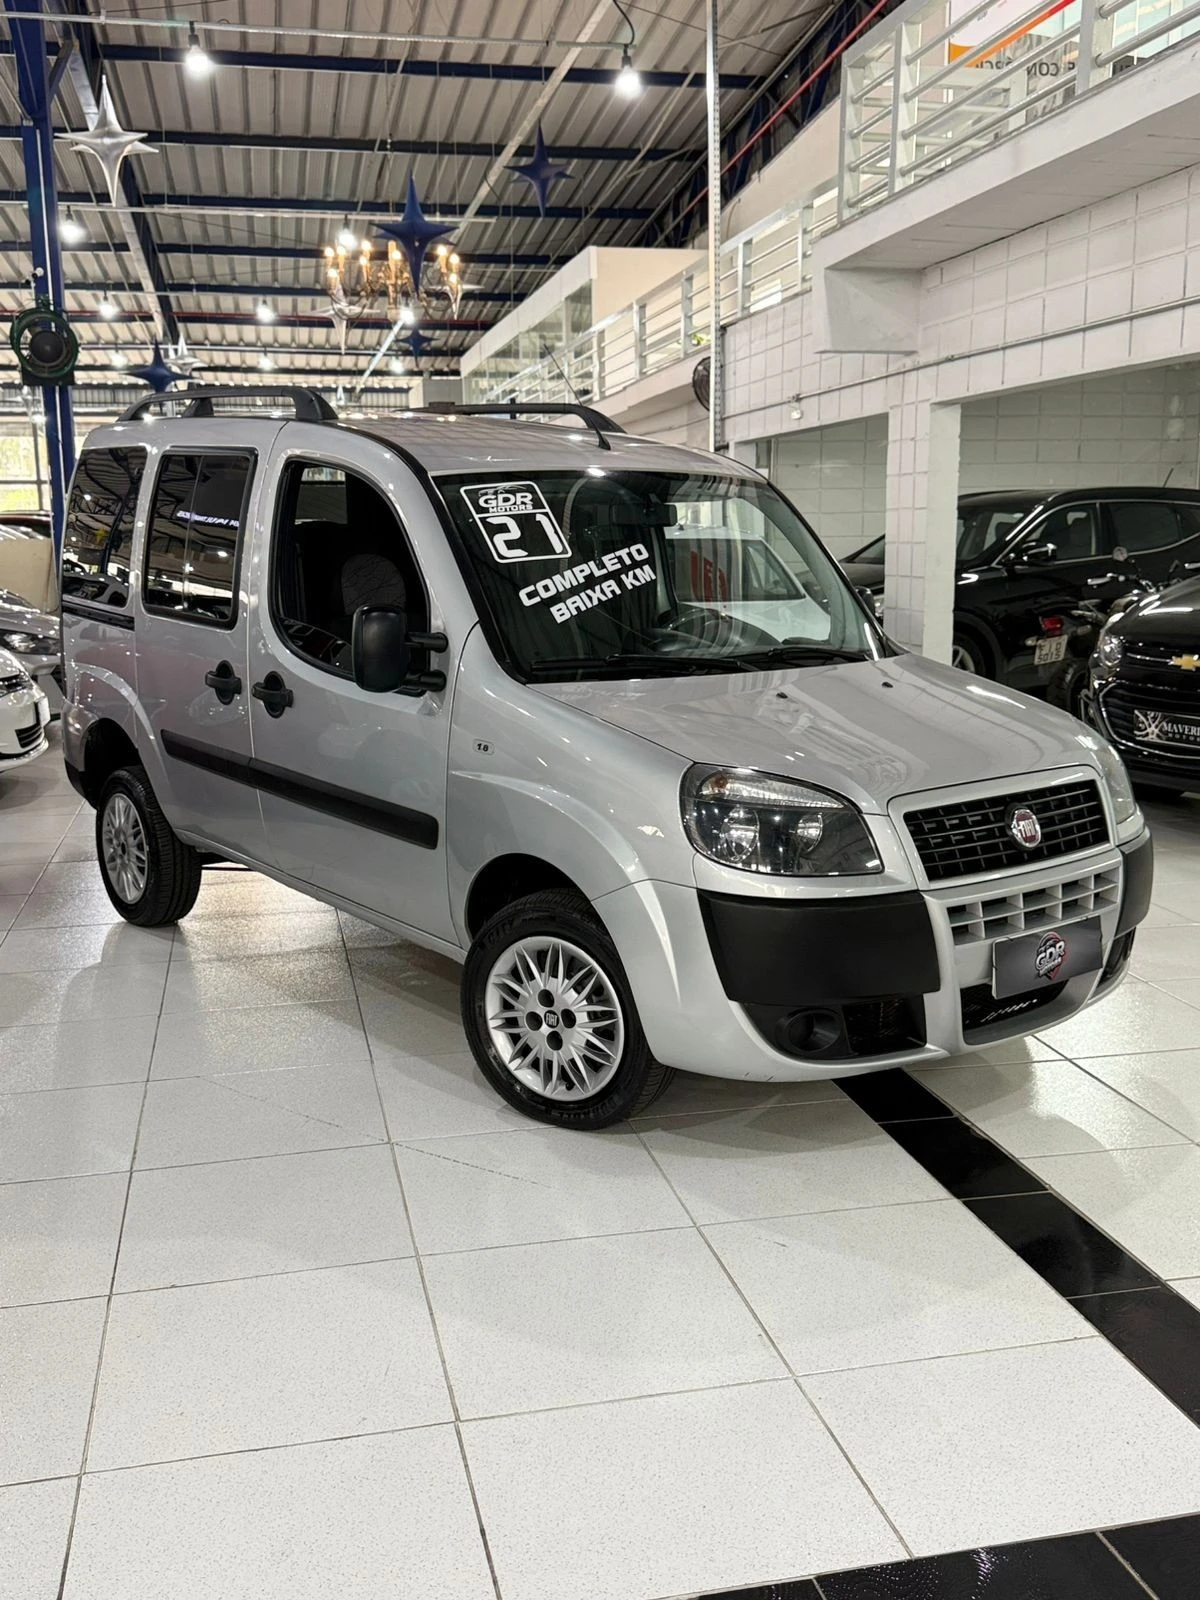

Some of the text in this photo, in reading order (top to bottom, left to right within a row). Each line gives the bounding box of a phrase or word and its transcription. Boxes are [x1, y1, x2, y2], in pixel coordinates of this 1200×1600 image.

[478, 492, 533, 508] GDR
[489, 504, 533, 513] MOTORS
[485, 513, 563, 558] 21
[518, 543, 650, 607] COMPLETO
[549, 564, 657, 624] BAIXA KM
[1036, 940, 1065, 970] GDR
